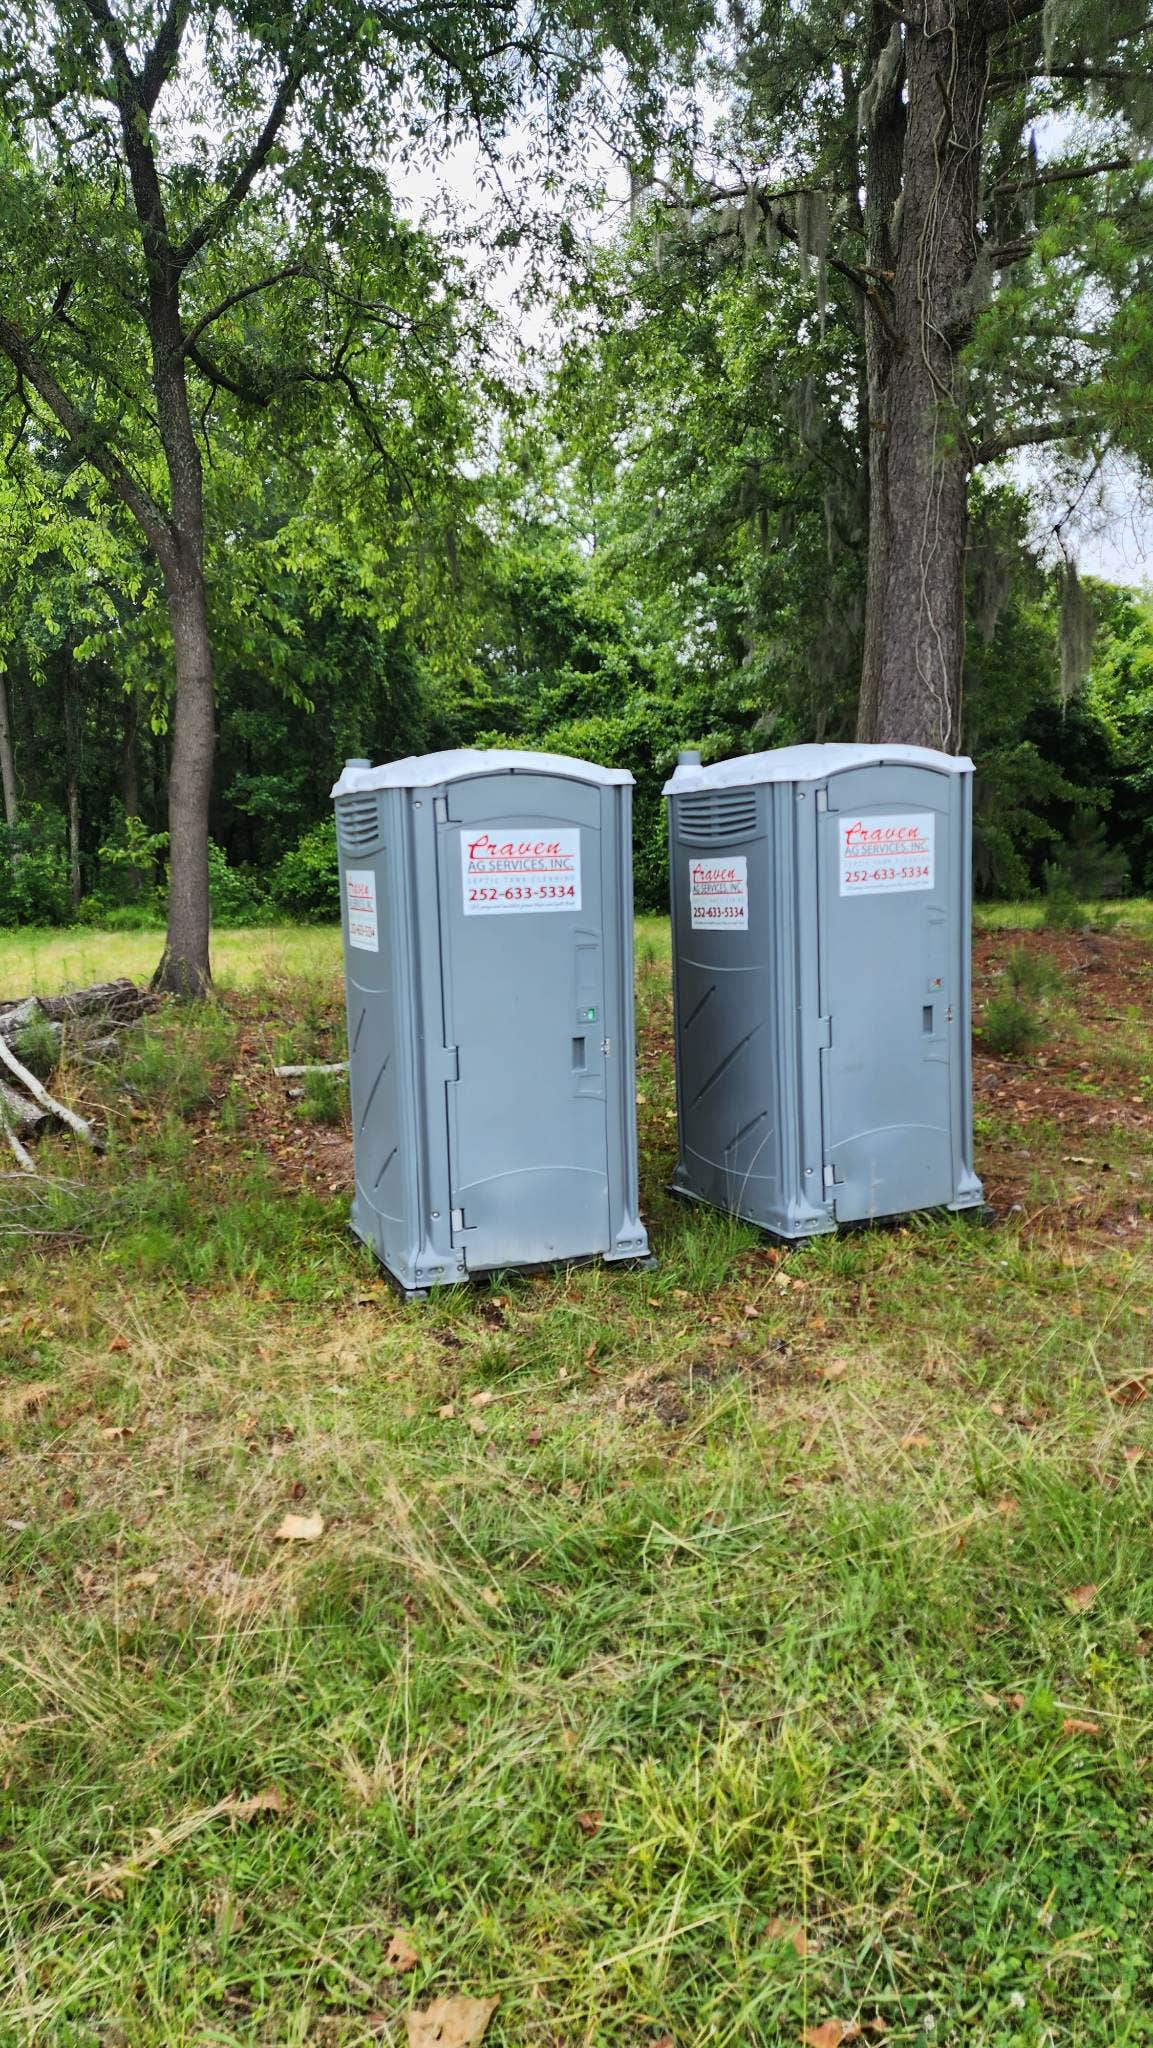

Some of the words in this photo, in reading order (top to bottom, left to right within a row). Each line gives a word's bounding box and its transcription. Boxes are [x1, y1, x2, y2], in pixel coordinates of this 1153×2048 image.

[845, 821, 918, 844] Craven
[467, 835, 560, 860] Craven
[468, 861, 485, 872] AG
[489, 859, 548, 871] SERVICES,
[845, 866, 929, 883] 252-633-5334
[469, 885, 575, 901] 252-633-5334
[693, 906, 744, 918] 252-633-5334
